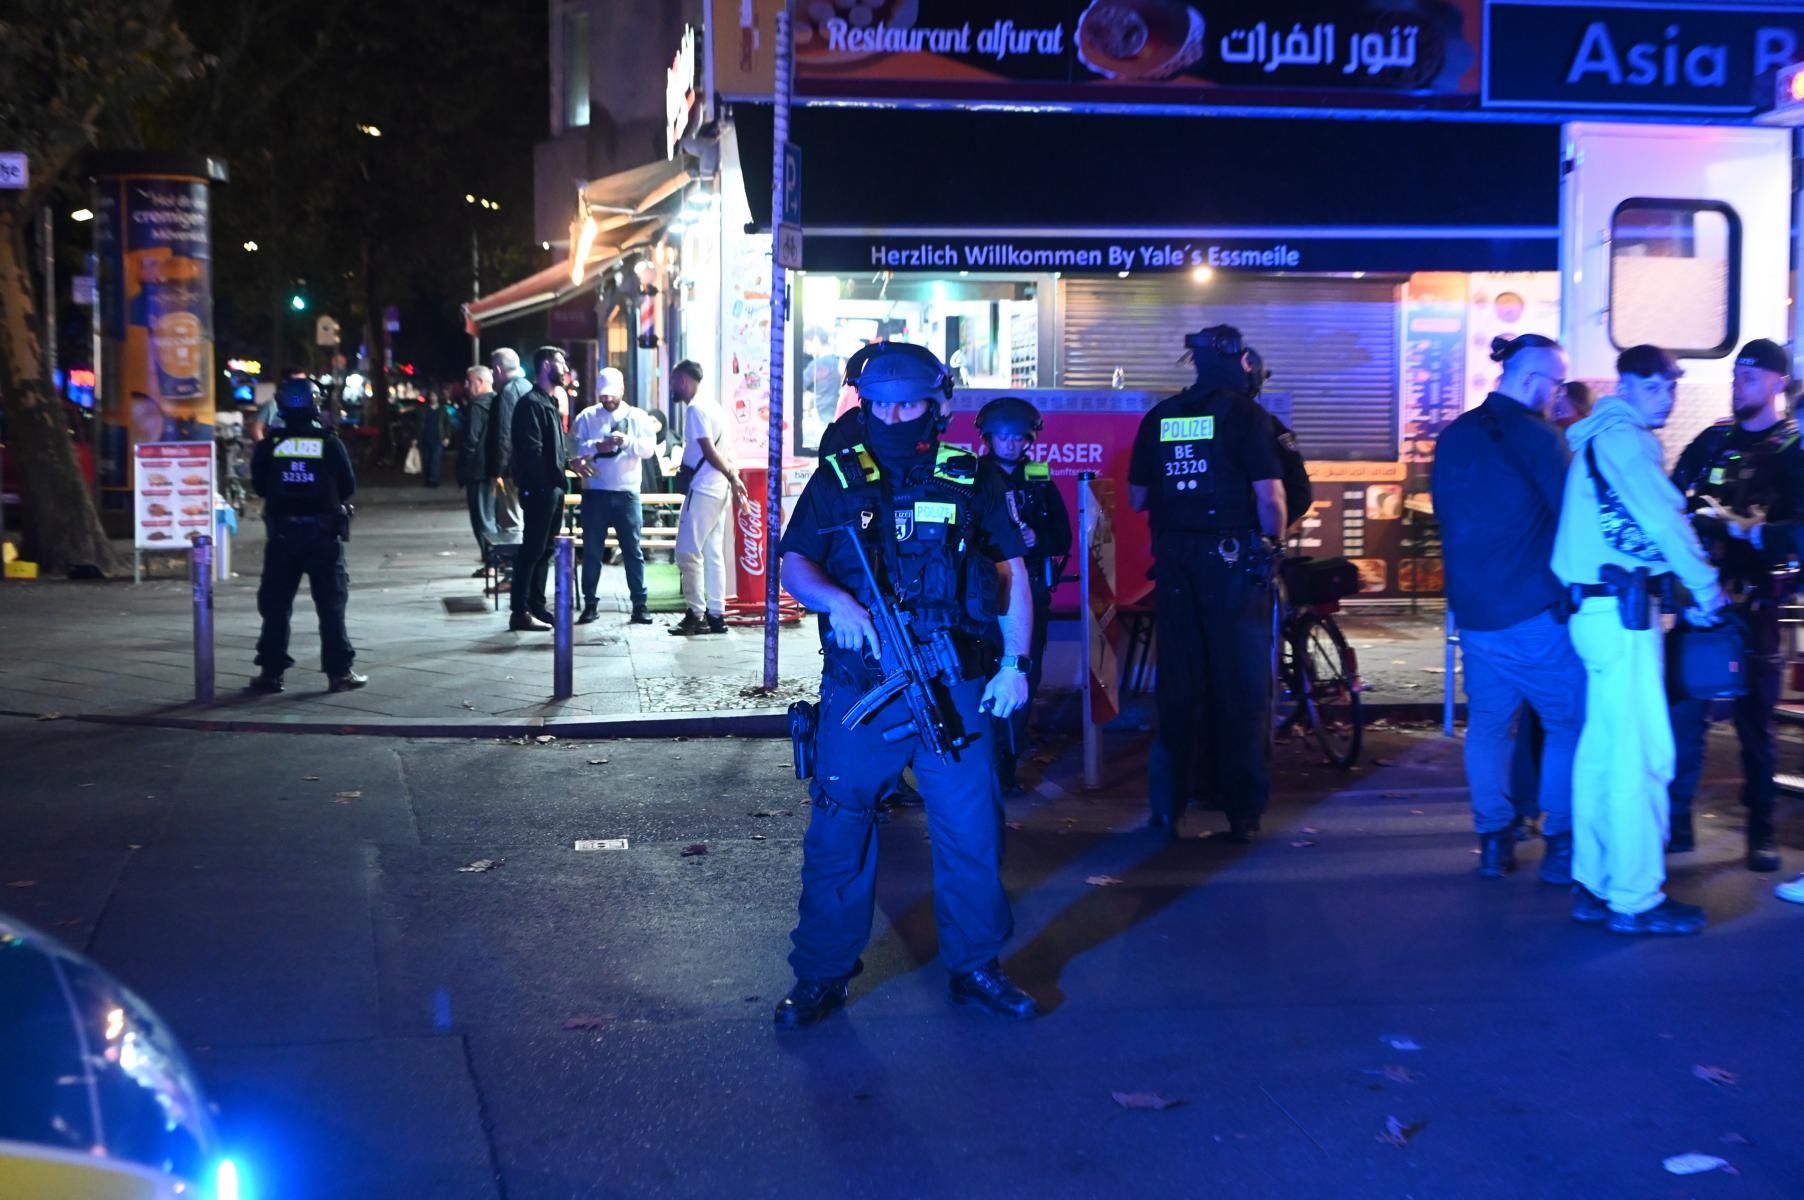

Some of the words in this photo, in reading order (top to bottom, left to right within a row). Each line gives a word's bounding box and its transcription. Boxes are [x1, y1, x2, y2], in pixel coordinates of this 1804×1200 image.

[827, 17, 972, 54] Restaurant
[977, 20, 1064, 60] alfurat
[1220, 21, 1336, 73] الفرات
[1342, 25, 1420, 75] تنور
[1565, 21, 1729, 87] Asia
[785, 154, 797, 213] P
[871, 244, 957, 266] Herzlich
[964, 244, 1101, 266] Willkommen
[1108, 245, 1136, 271] By
[1208, 244, 1300, 267] Essmeile
[1161, 418, 1213, 440] POLIZEI
[1174, 444, 1195, 460] BE
[281, 472, 316, 482] 32334
[290, 461, 307, 472] BE
[1165, 459, 1208, 477] 32320
[917, 504, 954, 521] POLIZEI
